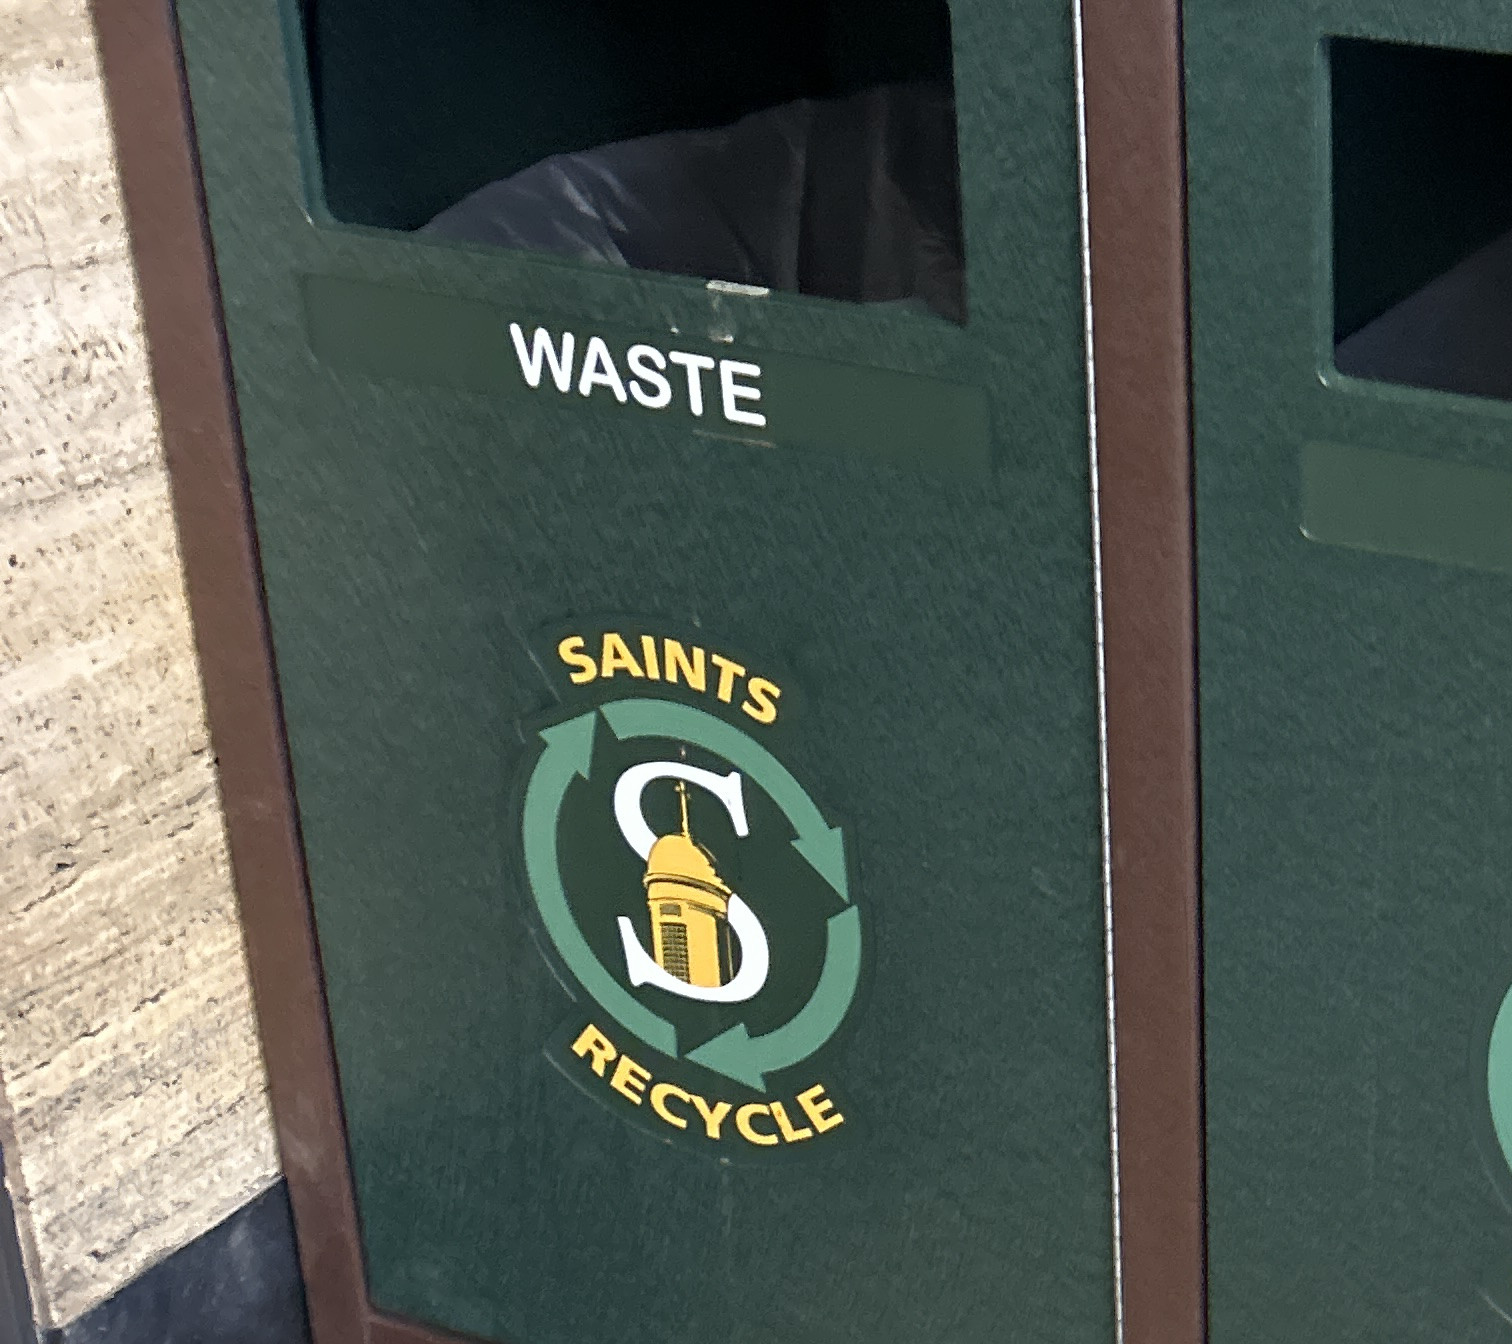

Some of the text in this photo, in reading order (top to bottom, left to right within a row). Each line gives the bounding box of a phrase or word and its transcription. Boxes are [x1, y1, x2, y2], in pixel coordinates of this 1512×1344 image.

[509, 322, 767, 427] WASTE
[559, 632, 782, 725] SAINTS
[571, 1023, 845, 1147] RECYCLE
